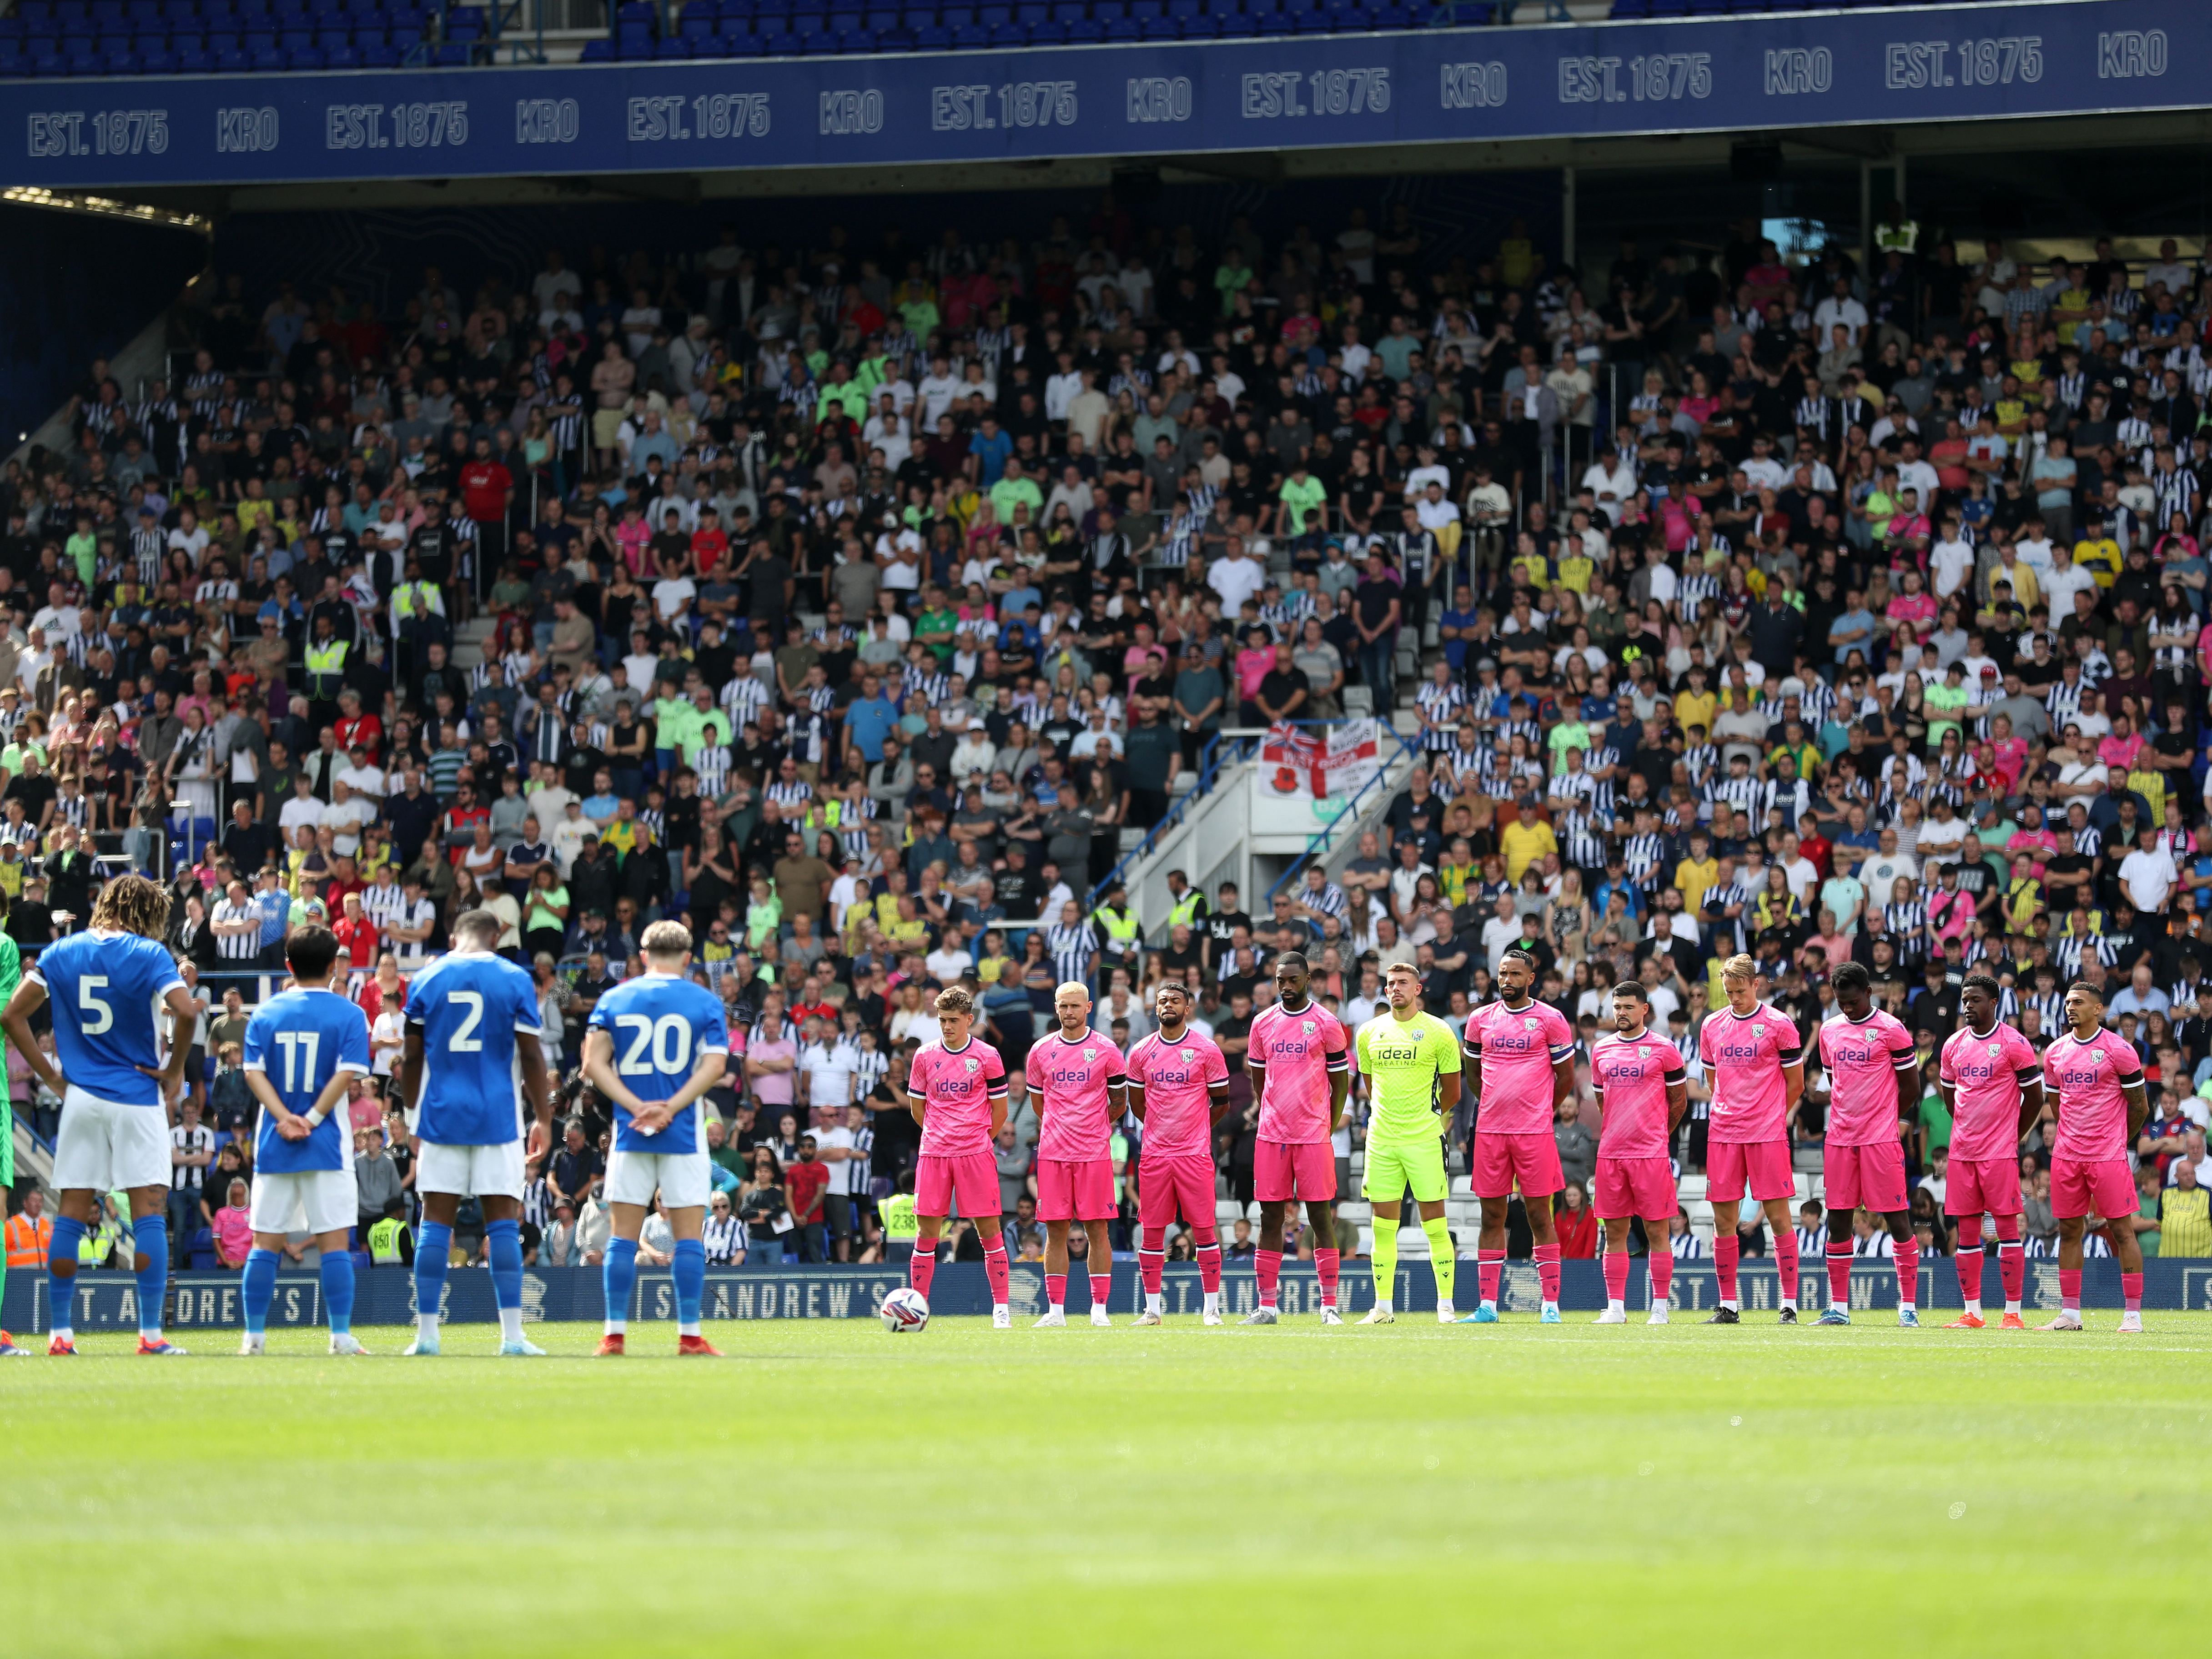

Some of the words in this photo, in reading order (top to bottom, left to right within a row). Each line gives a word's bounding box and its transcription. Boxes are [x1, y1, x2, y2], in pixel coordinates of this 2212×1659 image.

[1764, 46, 1833, 95] KRO
[2098, 29, 2168, 79] KRO
[1127, 76, 1192, 123] KRO
[1441, 60, 1508, 109] KRO
[216, 106, 279, 153] KRO
[515, 98, 579, 144] KRO
[820, 89, 884, 135] KRO
[79, 975, 114, 1036] 5
[447, 990, 484, 1052] 2
[615, 1013, 692, 1076] 20
[1272, 1039, 1307, 1053] ideal
[1378, 1046, 1417, 1060] ideal
[1491, 1034, 1530, 1049] ideal
[1720, 1043, 1757, 1057] ideal
[1834, 1047, 1870, 1061] ideal
[275, 1031, 320, 1093] 11
[1051, 1068, 1090, 1081] ideal
[1151, 1068, 1189, 1082] ideal
[1605, 1064, 1644, 1077] ideal
[1957, 1062, 1993, 1077] ideal
[2060, 1069, 2097, 1083] ideal
[935, 1078, 973, 1092] ideal
[893, 1214, 915, 1230] 238
[79, 1287, 301, 1322] T.ADRE'S
[655, 1282, 887, 1318] S.ANDREW'S
